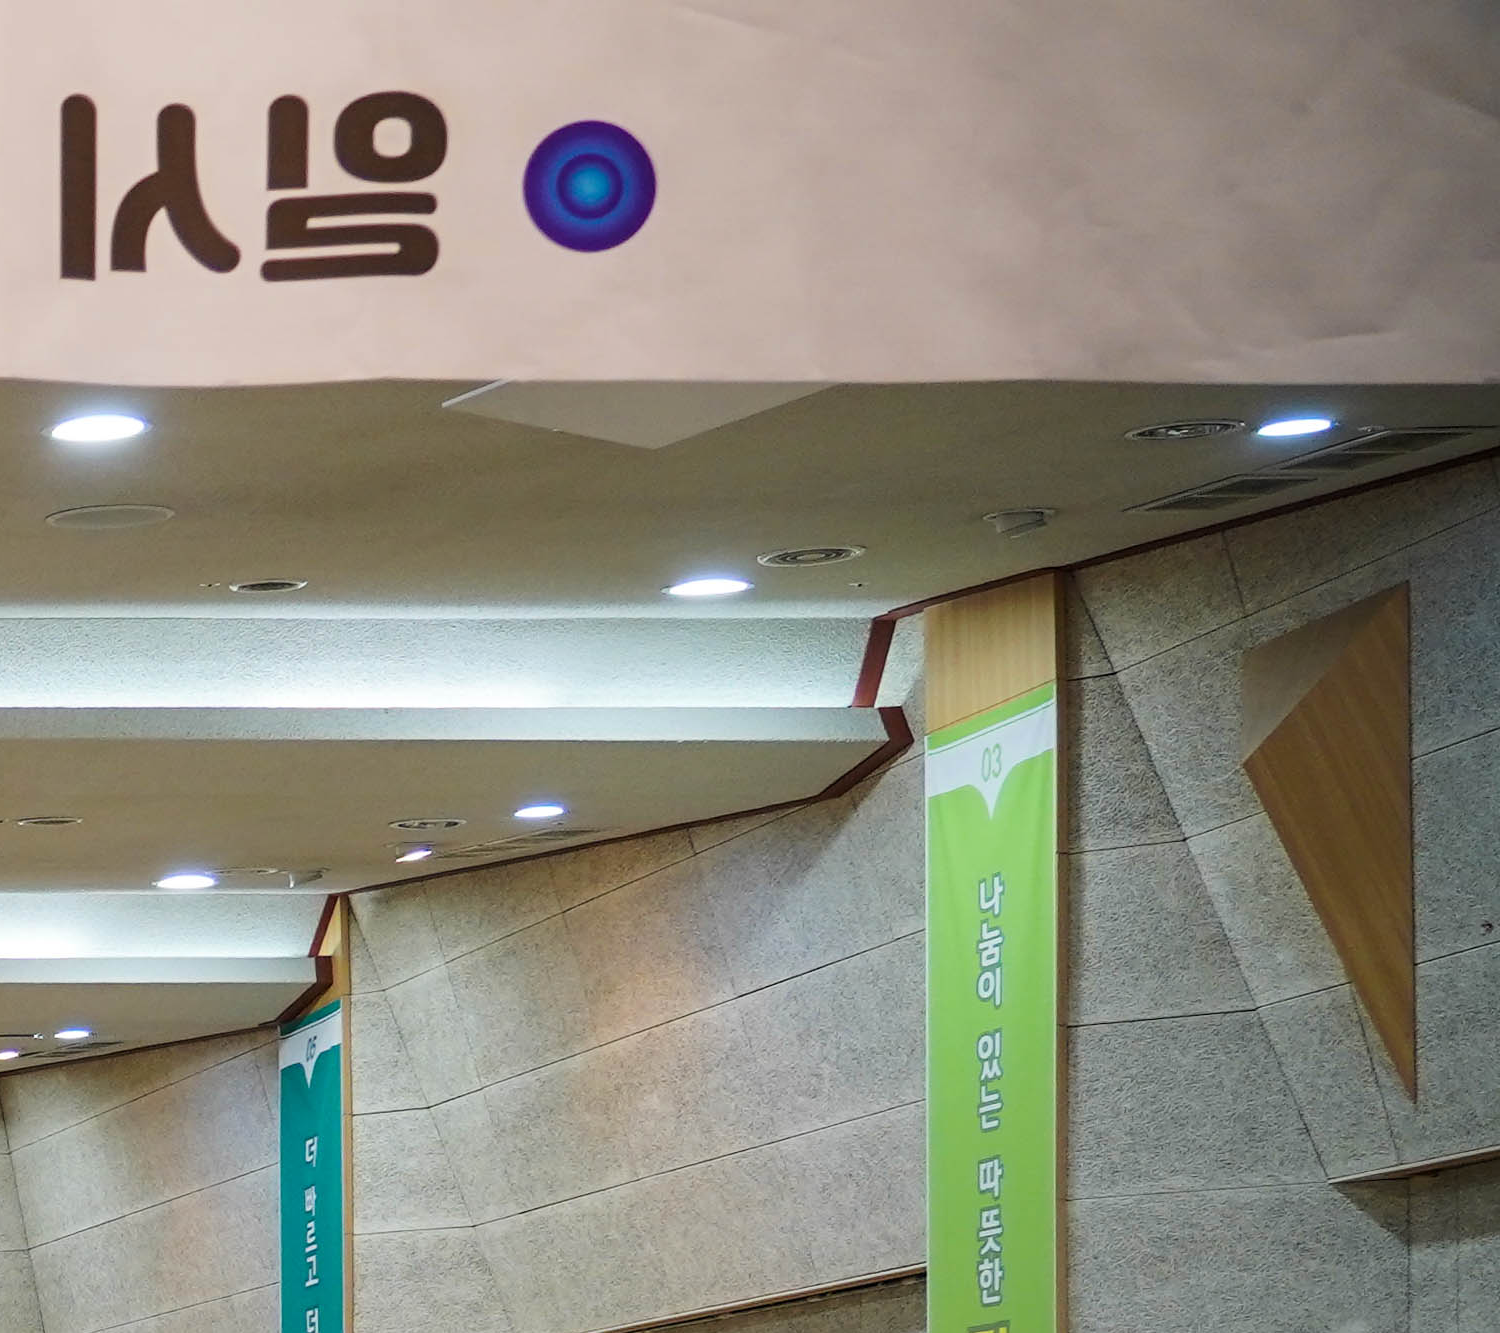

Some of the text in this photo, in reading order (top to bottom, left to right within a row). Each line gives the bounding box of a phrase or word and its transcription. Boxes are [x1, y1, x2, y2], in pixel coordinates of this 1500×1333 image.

[981, 743, 1002, 783] 03
[977, 875, 1004, 1005] 나눔이
[977, 1031, 1002, 1129] 있는
[304, 1136, 318, 1166] 더
[303, 1185, 318, 1287] 빠르고
[978, 1159, 1003, 1304] 따뜻한
